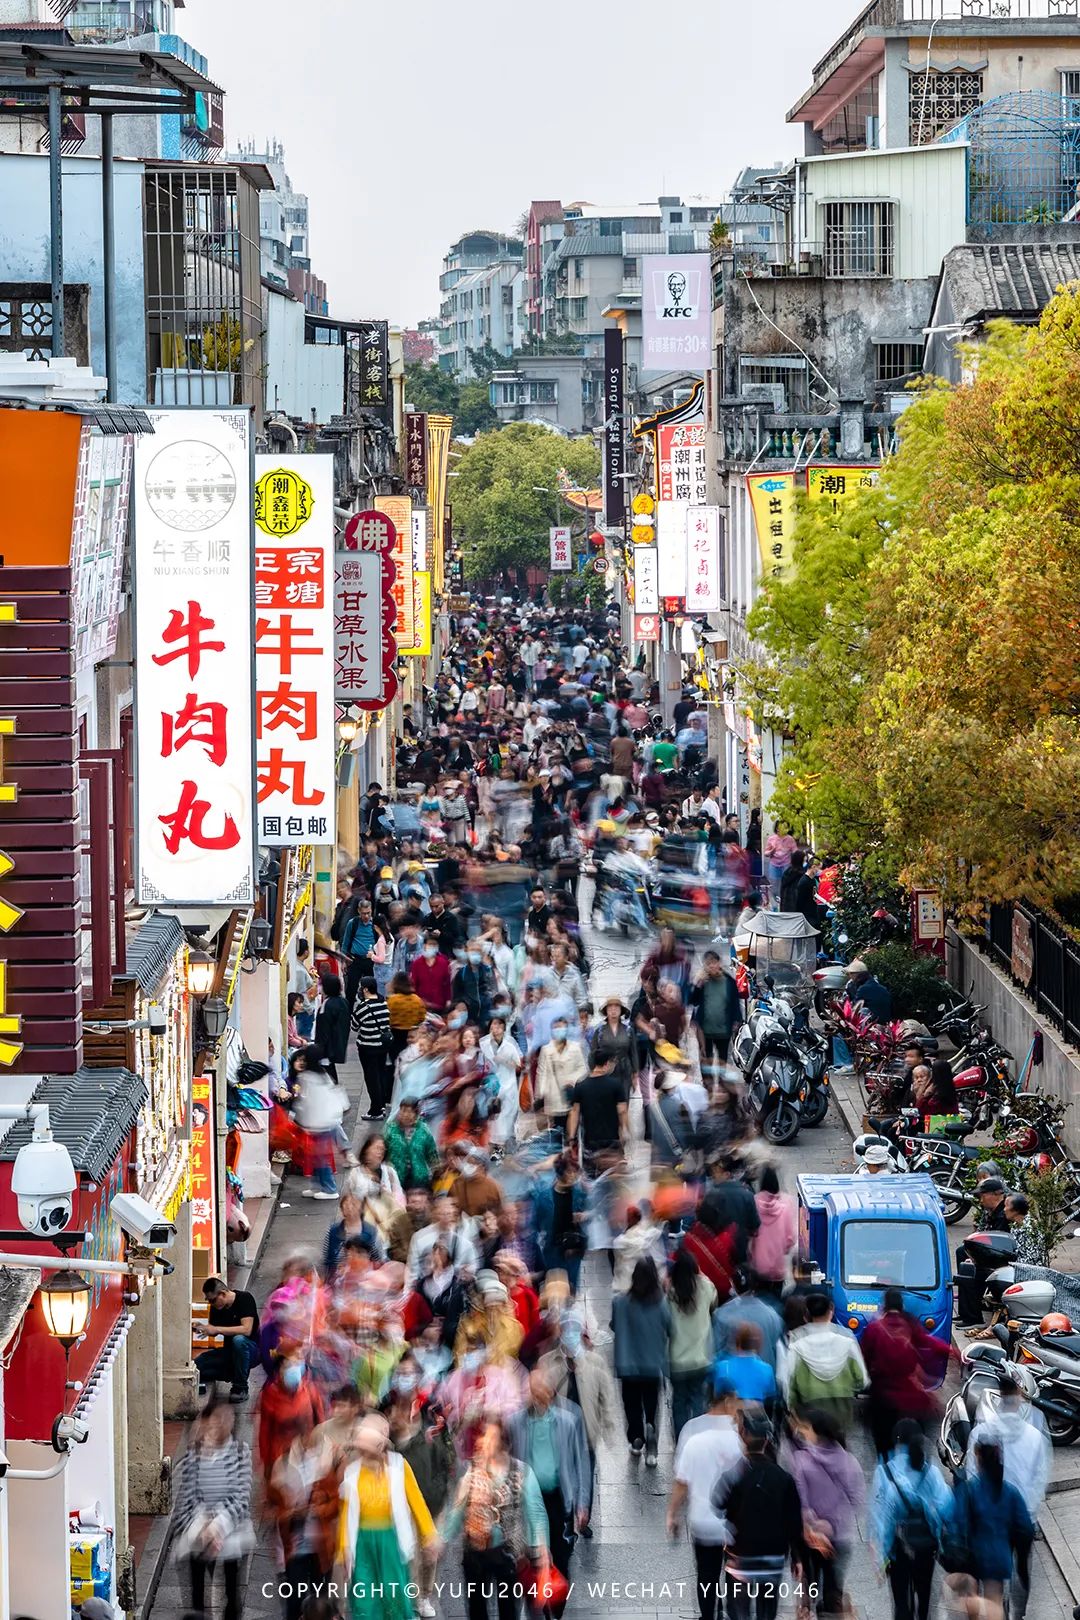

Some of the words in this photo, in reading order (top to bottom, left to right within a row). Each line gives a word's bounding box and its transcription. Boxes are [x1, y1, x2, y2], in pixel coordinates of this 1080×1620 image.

[662, 307, 692, 318] KFC
[153, 540, 231, 563] 牛香顺
[256, 551, 322, 575] 正宗
[693, 518, 711, 596] 刘记卤鹅
[153, 567, 171, 576] NIU
[172, 567, 201, 576] XIANG
[203, 567, 230, 576] SHUN
[336, 589, 369, 690] 甘草水果
[256, 614, 325, 806] 牛肉丸
[151, 600, 241, 855] 牛肉丸
[258, 816, 328, 838] 国包邮
